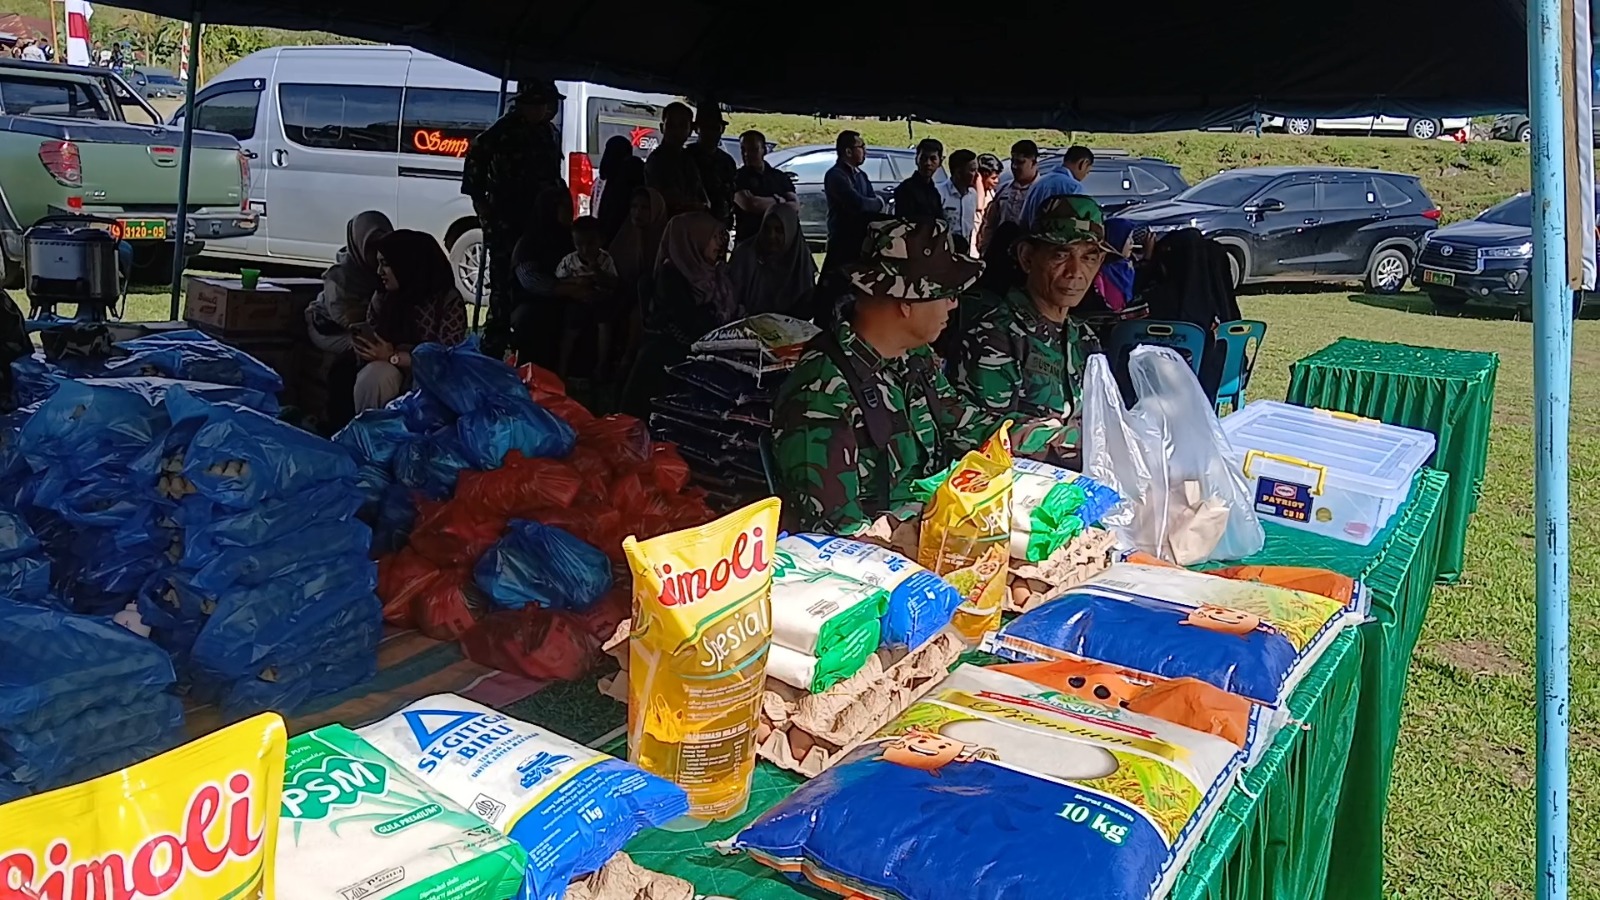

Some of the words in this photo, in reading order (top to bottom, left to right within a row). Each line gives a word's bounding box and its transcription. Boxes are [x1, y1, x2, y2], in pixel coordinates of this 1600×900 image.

[125, 226, 165, 238] 3120-05
[1263, 495, 1305, 509] PATRIOT
[701, 599, 769, 672] Spesial
[456, 724, 514, 760] BIRU
[968, 702, 1133, 746] Premium
[282, 761, 380, 818] PSM
[378, 821, 401, 833] GULA
[1054, 802, 1090, 823] 10
[1091, 813, 1129, 844] kg
